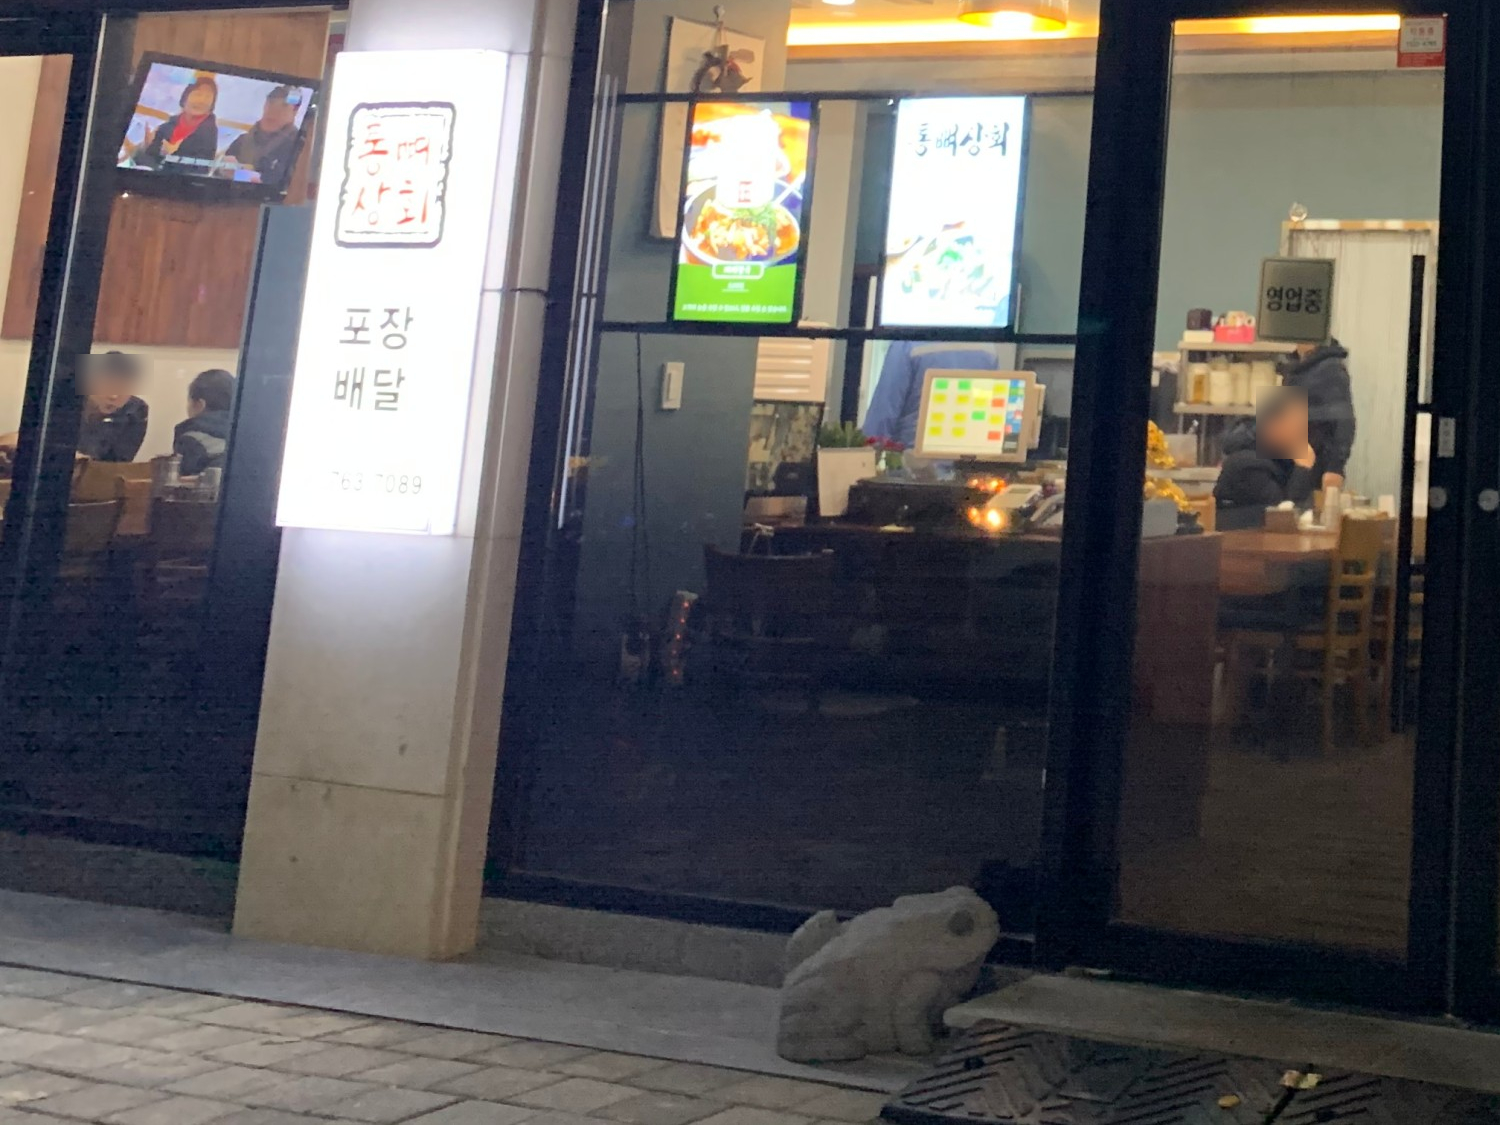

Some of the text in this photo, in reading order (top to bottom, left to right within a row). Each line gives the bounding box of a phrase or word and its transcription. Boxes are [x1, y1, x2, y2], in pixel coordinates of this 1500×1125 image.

[1266, 286, 1322, 313] 영업중
[339, 306, 413, 350] 포장
[333, 367, 406, 412] 배달
